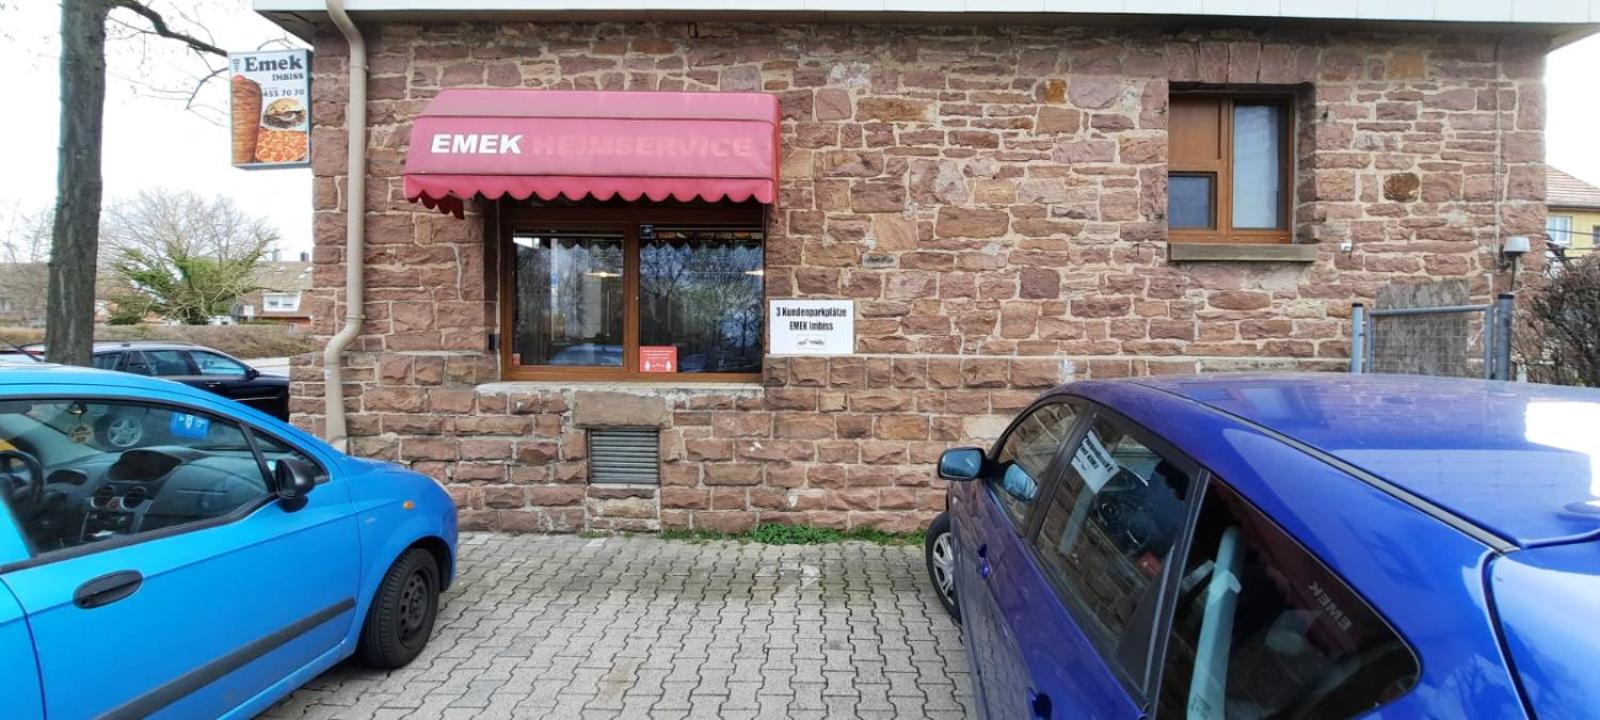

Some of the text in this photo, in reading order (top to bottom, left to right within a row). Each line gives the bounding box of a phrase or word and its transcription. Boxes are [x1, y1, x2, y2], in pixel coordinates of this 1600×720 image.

[244, 55, 303, 72] Emek
[272, 72, 304, 81] IMBISS
[430, 133, 753, 157] EMEK HEIMSERVICE
[775, 306, 847, 318] 3 Kundenparkplätze
[789, 321, 807, 331] EMEK
